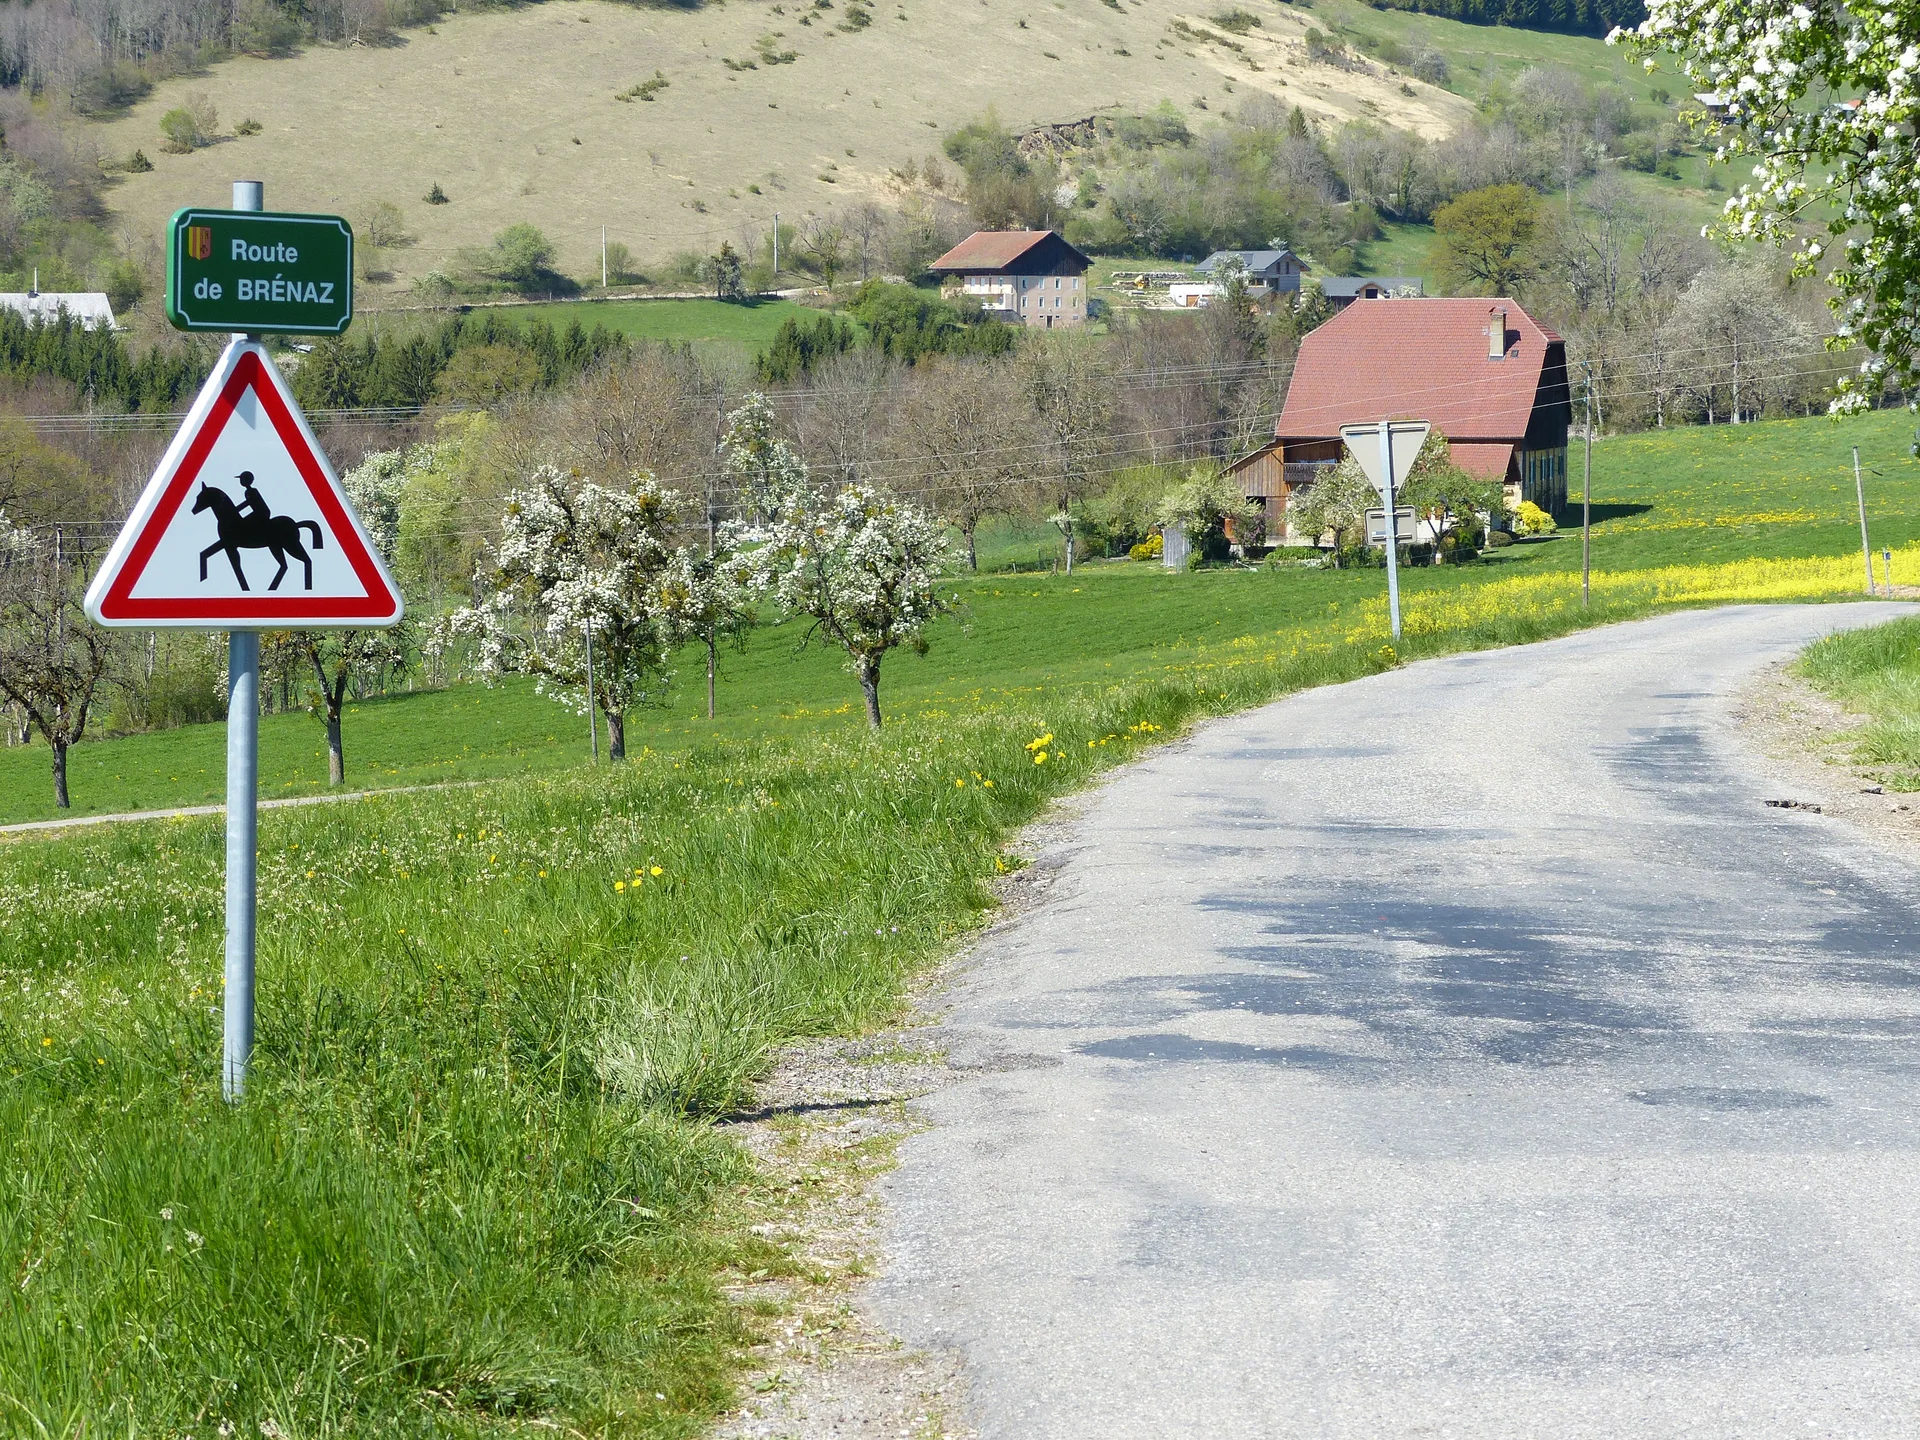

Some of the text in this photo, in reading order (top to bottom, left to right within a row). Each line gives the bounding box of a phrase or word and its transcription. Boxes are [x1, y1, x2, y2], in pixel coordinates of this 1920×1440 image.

[232, 239, 298, 263] Route
[194, 274, 334, 303] de BRÉNAZ
